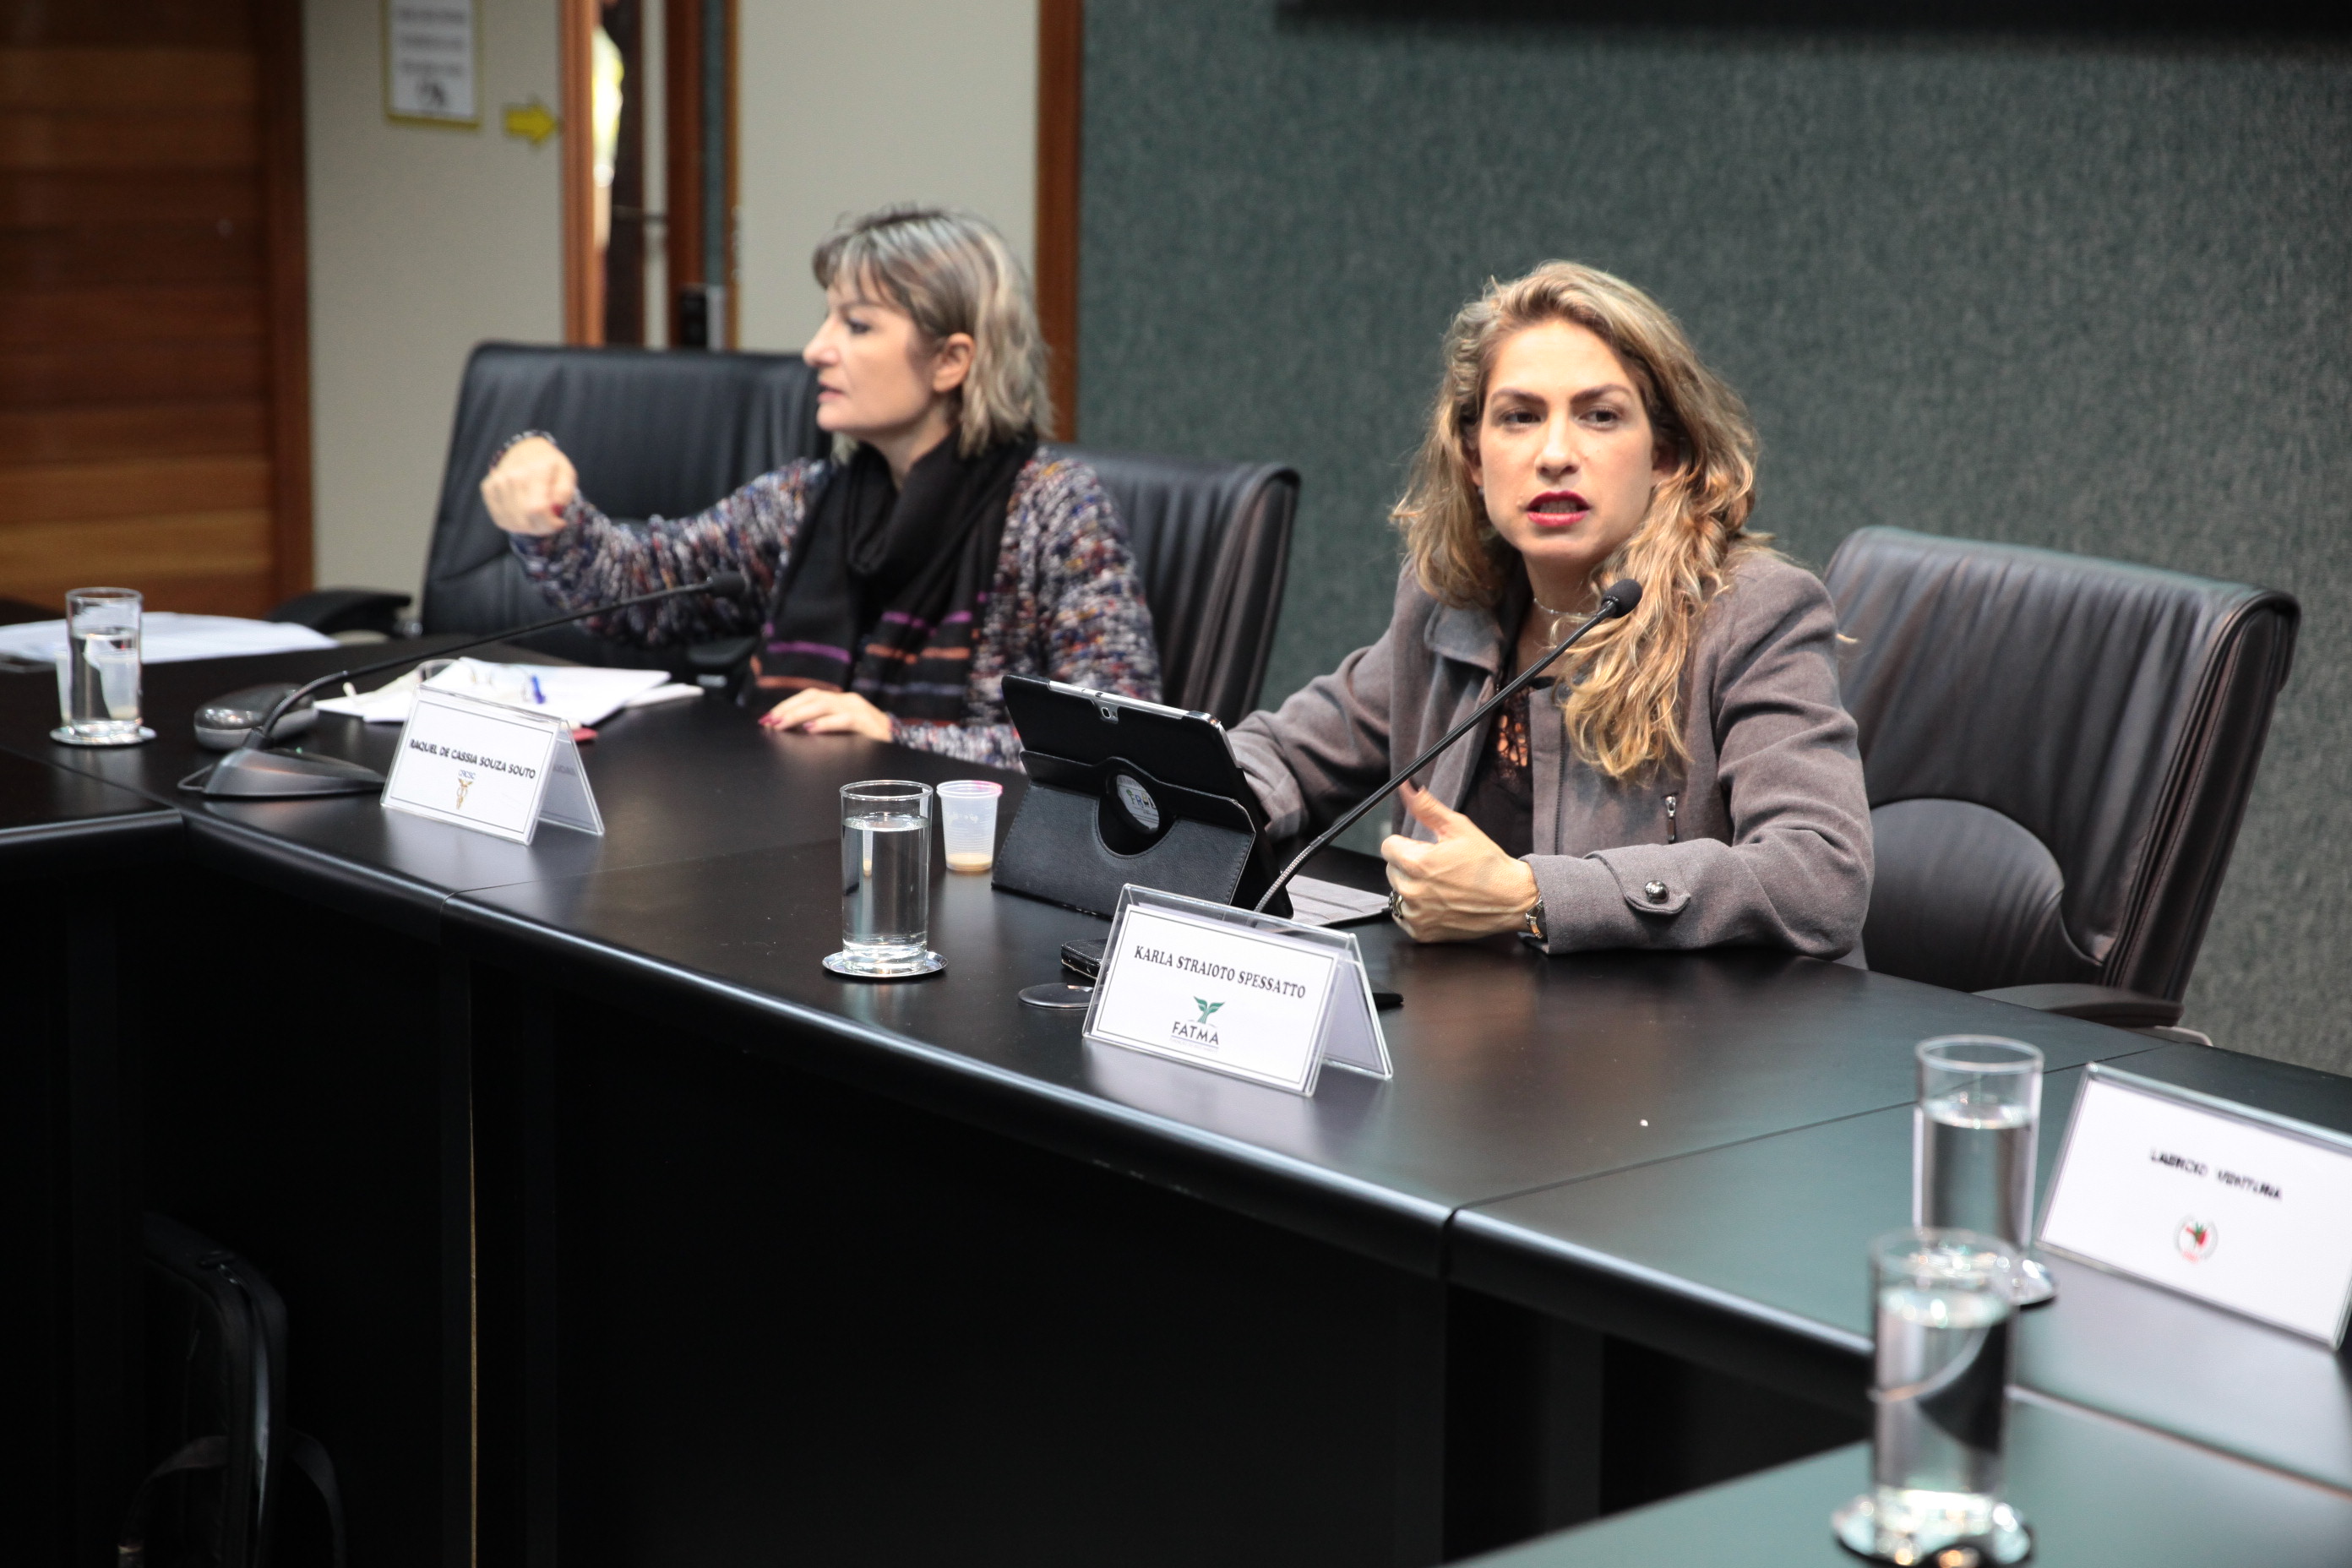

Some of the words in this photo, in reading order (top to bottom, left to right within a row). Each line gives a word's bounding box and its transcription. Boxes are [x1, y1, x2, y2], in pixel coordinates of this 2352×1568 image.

[439, 747, 449, 757] DE
[451, 750, 477, 764] CASSIA
[479, 756, 507, 772] SOUZA
[508, 764, 536, 778] SOUTO
[1134, 945, 1173, 967] KARLA
[1176, 956, 1235, 982] STRAIOTO
[1238, 971, 1306, 999] SPESSATTO
[1172, 1021, 1219, 1046] FATMA
